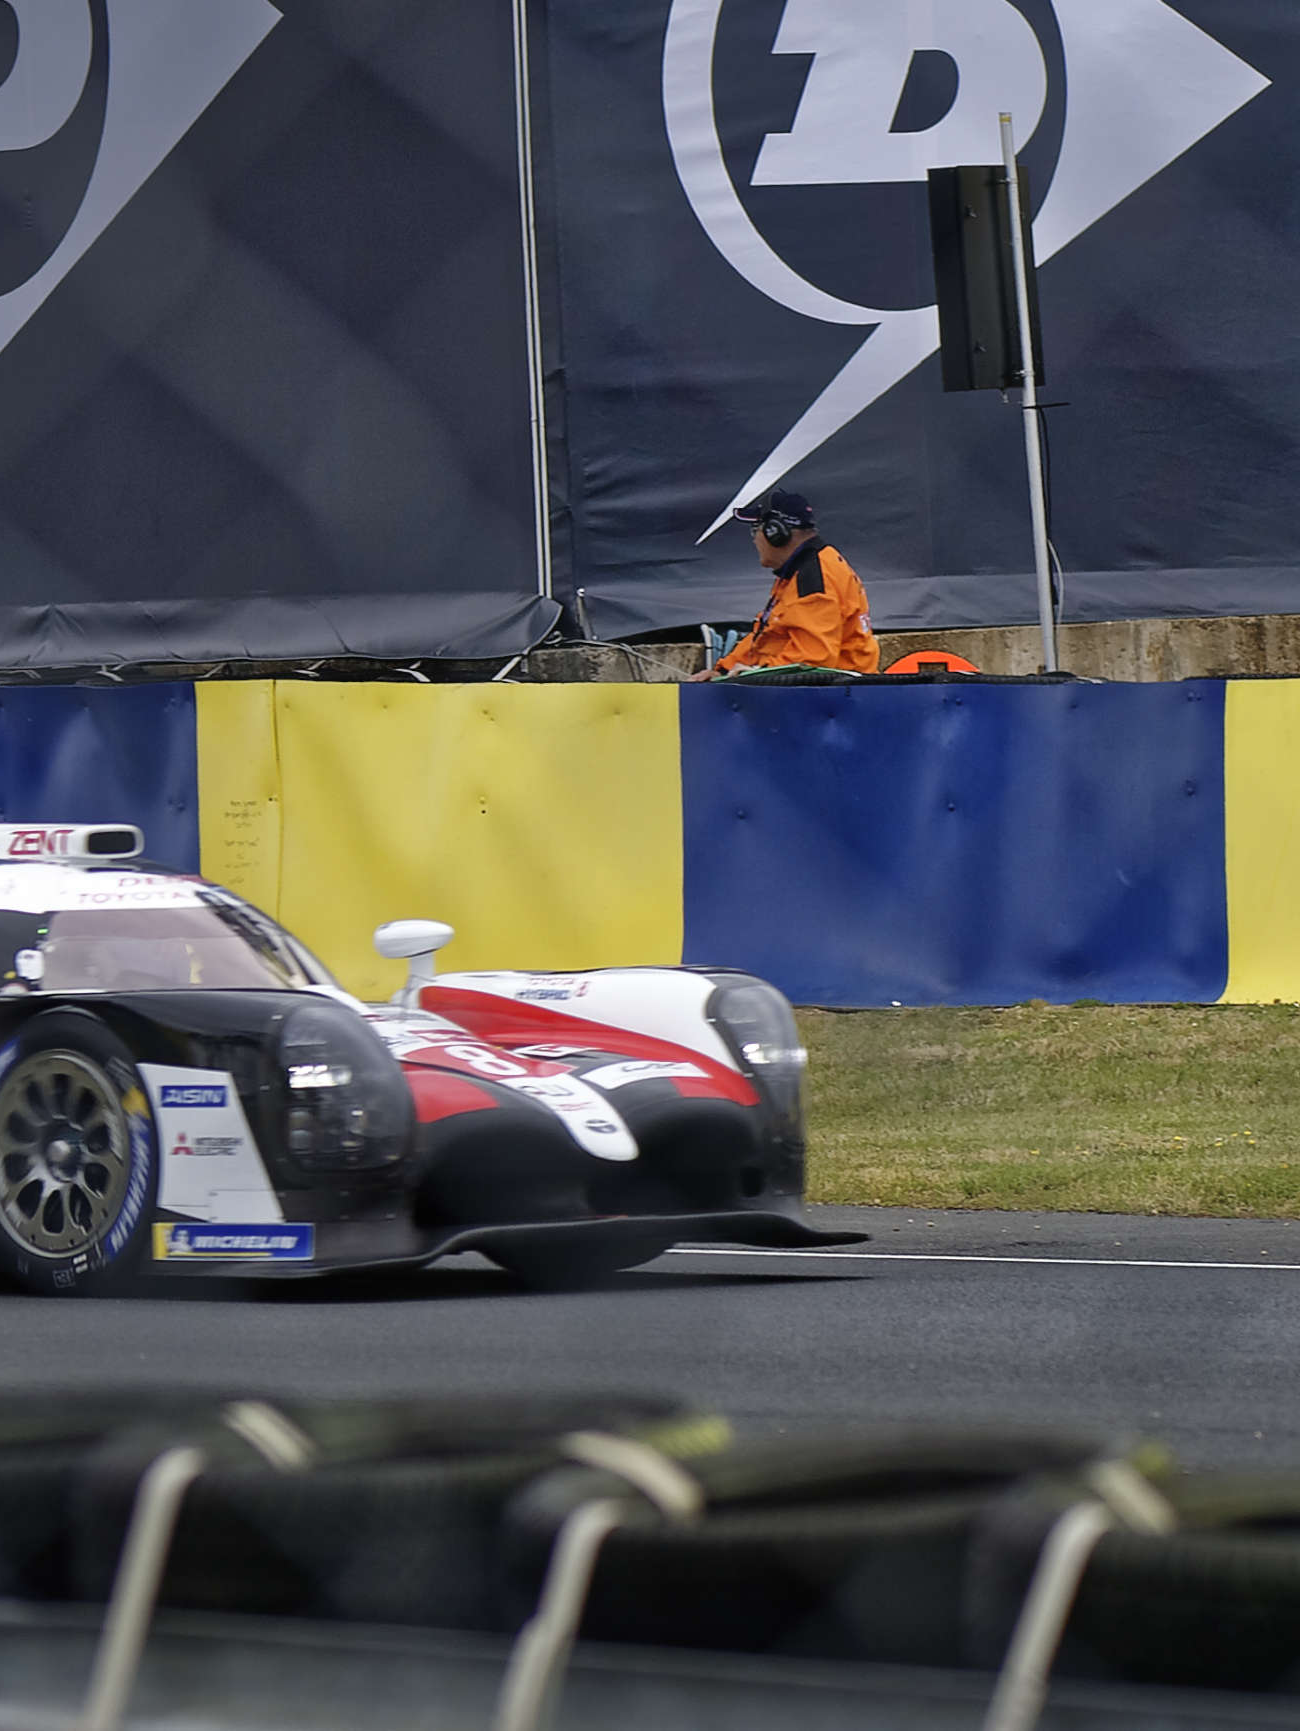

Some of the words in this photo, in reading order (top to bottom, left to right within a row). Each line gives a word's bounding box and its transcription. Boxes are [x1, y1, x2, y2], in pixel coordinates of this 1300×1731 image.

[7, 828, 75, 856] ZENT
[163, 1088, 226, 1105] AISIN
[191, 1235, 298, 1250] MICHELIN
